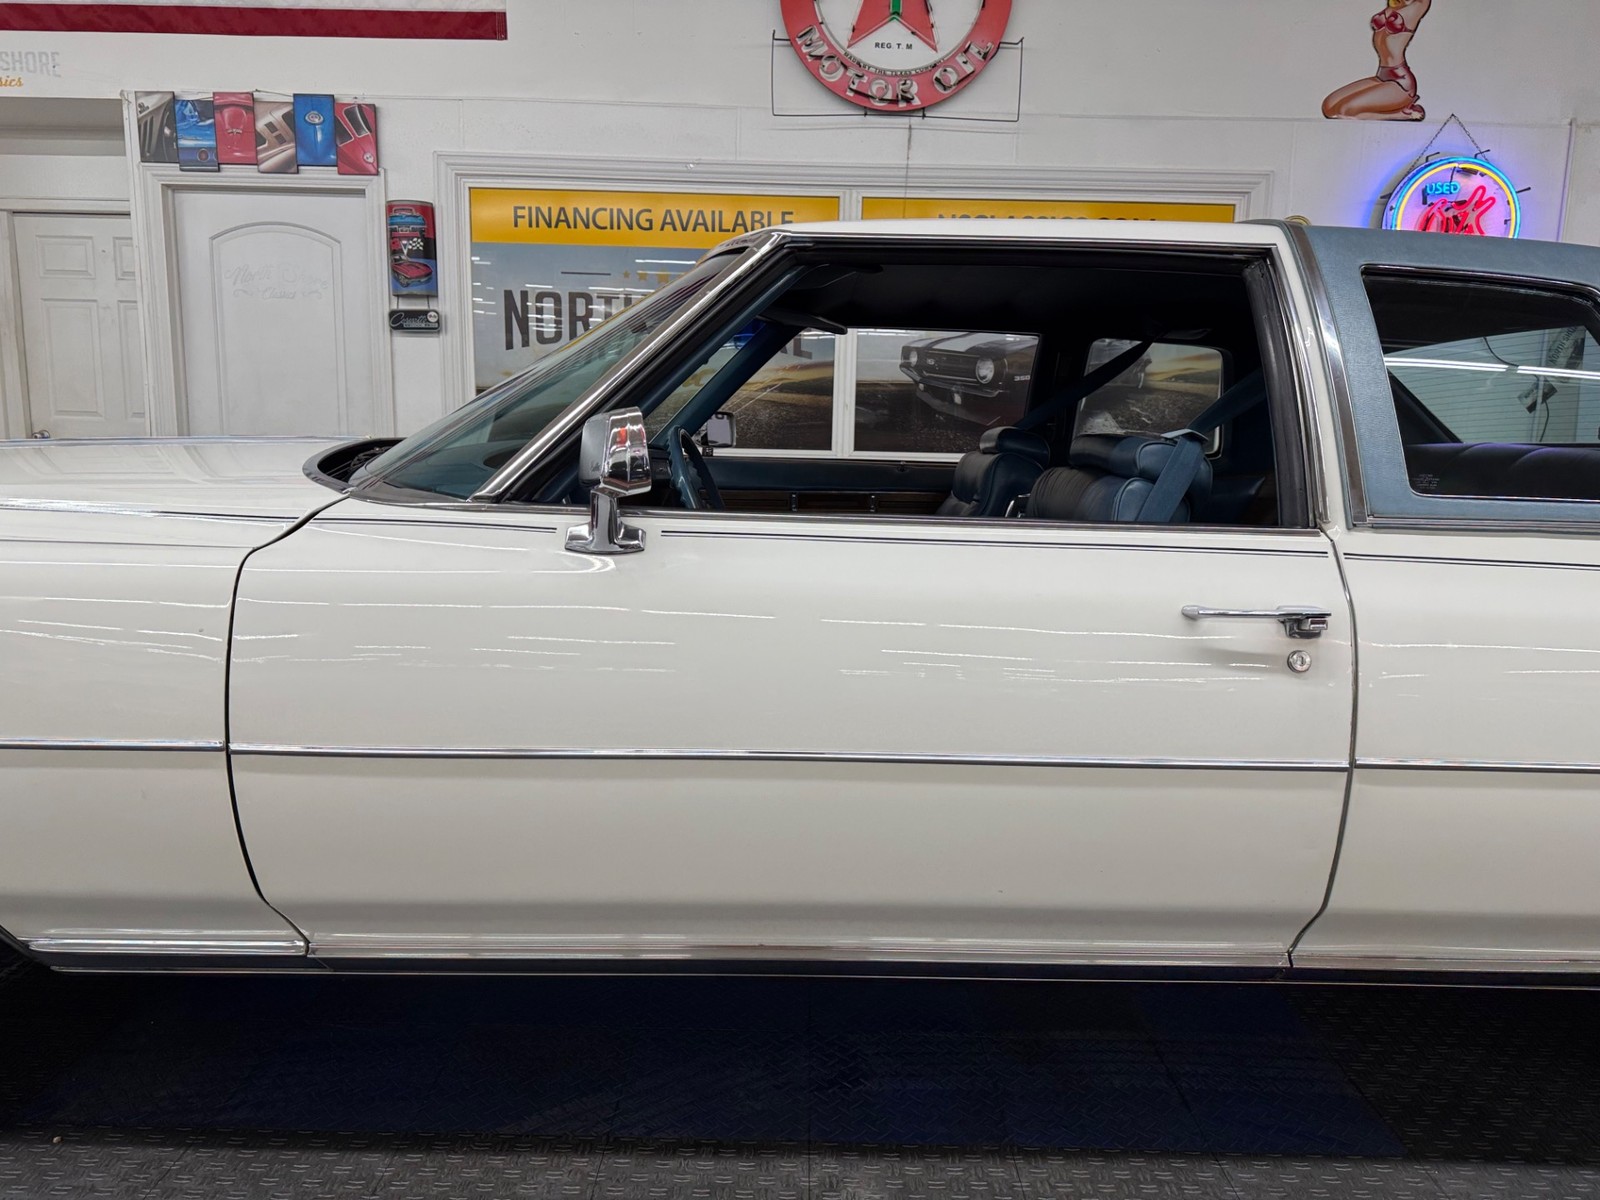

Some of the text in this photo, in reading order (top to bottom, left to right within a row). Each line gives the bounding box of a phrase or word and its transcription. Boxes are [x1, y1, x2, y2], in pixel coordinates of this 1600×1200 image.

[0, 51, 61, 78] SHORE
[796, 25, 994, 107] MOTOR OIL
[1426, 181, 1461, 195] USED
[513, 205, 653, 231] FINANCING
